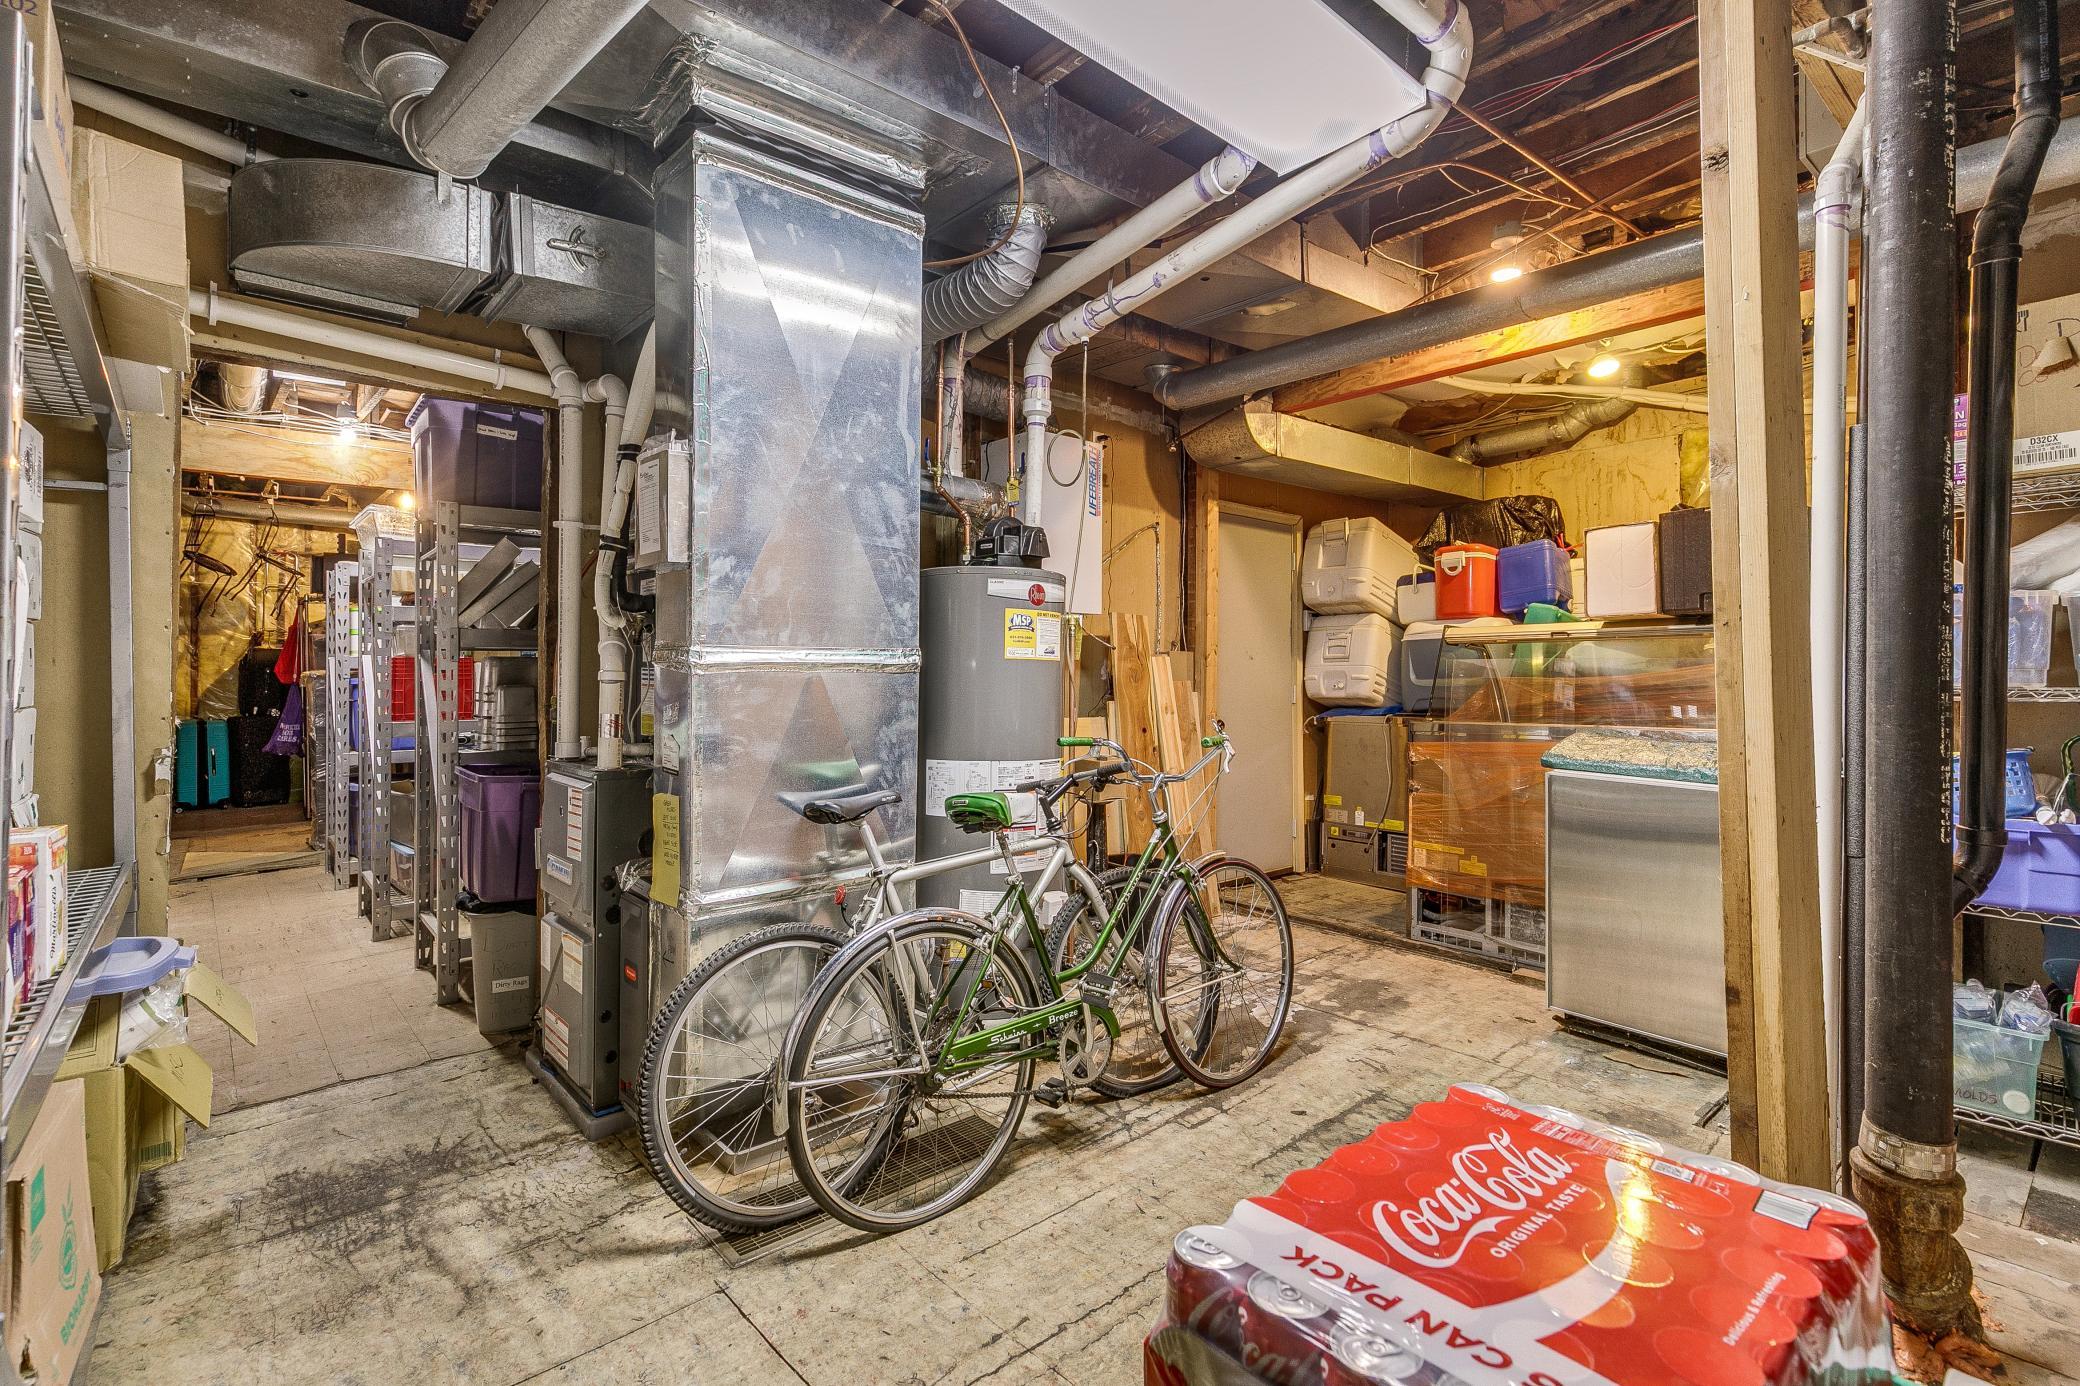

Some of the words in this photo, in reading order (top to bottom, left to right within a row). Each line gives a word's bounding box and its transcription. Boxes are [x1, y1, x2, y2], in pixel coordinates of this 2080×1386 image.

[2030, 435, 2059, 446] D32CX
[1088, 444, 1098, 517] LIFEBREATH
[1012, 614, 1032, 626] MSP
[495, 981, 511, 989] Dirty
[512, 979, 528, 987] Rags
[987, 1028, 1027, 1047] Schwinn
[1048, 1007, 1079, 1025] Breeze
[1372, 1127, 1573, 1268] Coca-Cola
[1490, 1211, 1553, 1259] ORIGINAL
[1545, 1183, 1587, 1212] TASTE
[1280, 1245, 1403, 1312] PACK
[1722, 1312, 1756, 1347] Delicious
[1751, 1271, 1788, 1308] Refreshing
[1403, 1309, 1514, 1370] CAN
